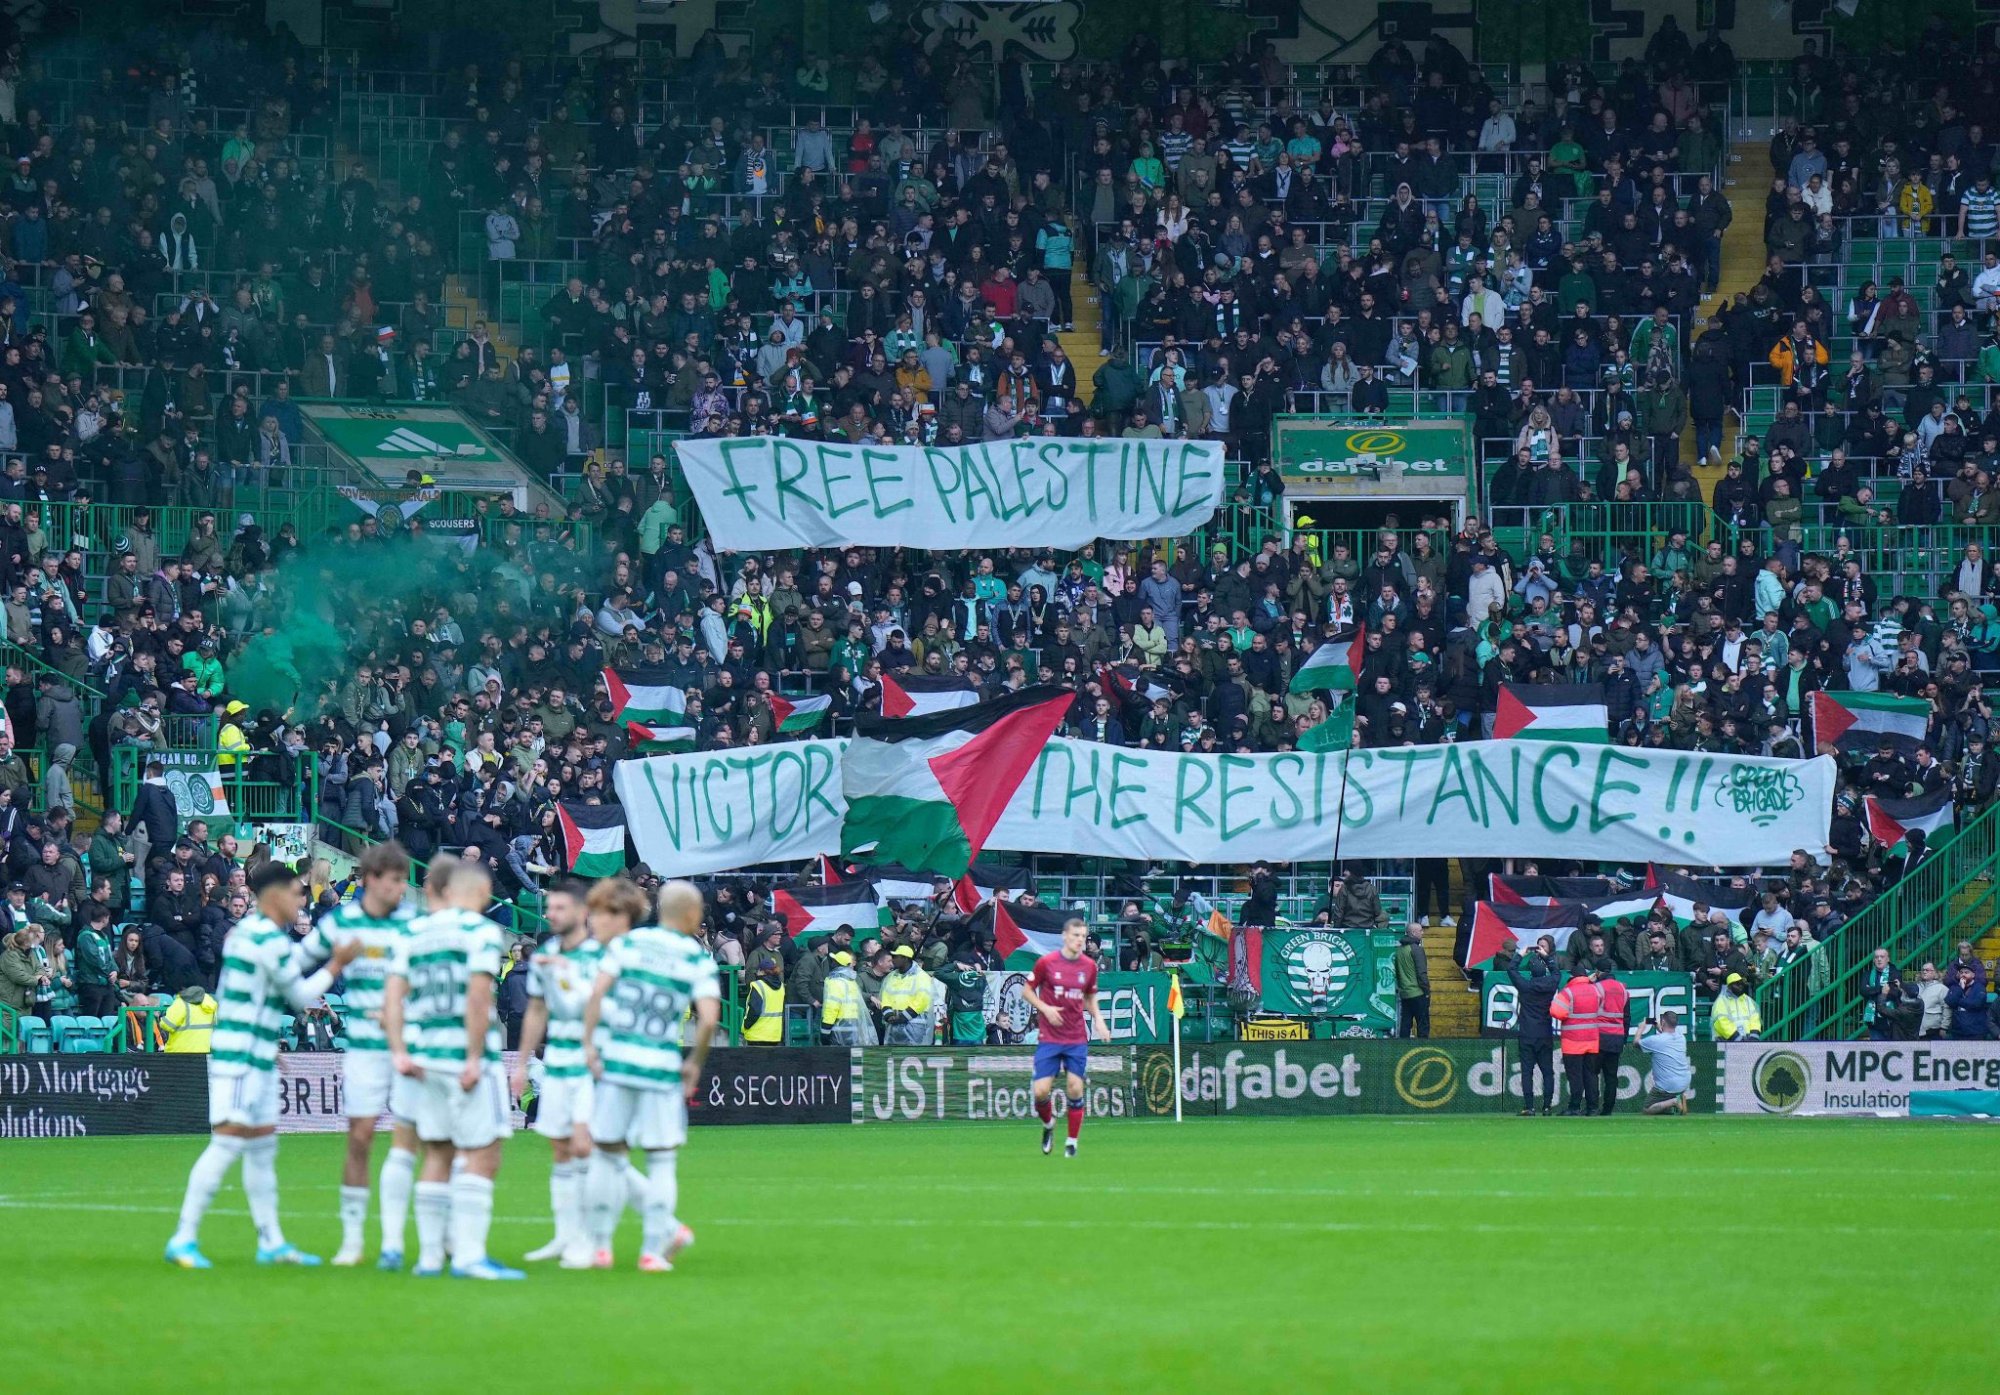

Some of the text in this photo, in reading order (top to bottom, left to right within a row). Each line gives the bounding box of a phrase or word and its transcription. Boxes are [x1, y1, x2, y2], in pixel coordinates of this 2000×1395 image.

[720, 437, 1213, 524] FREE PALESTINE
[1299, 457, 1448, 475] dafbet
[429, 519, 475, 529] SCOUSERS
[1730, 763, 1789, 788] GREEN
[643, 741, 849, 851] VICTOR
[1032, 742, 1149, 830] THE
[1727, 786, 1794, 813] BRIGADE
[1280, 932, 1310, 959] GREEN
[1312, 931, 1356, 960] BRIGADE
[613, 981, 674, 1037] 38
[1251, 1028, 1297, 1039] THIS IS A
[38, 1060, 150, 1102] Mortgage
[1180, 1049, 1362, 1110] dafabet
[1825, 1050, 1904, 1082] MPC
[708, 1080, 725, 1106] &
[733, 1074, 842, 1106] SECURITY
[872, 1056, 955, 1120] JST
[968, 1078, 1124, 1119] Electoics
